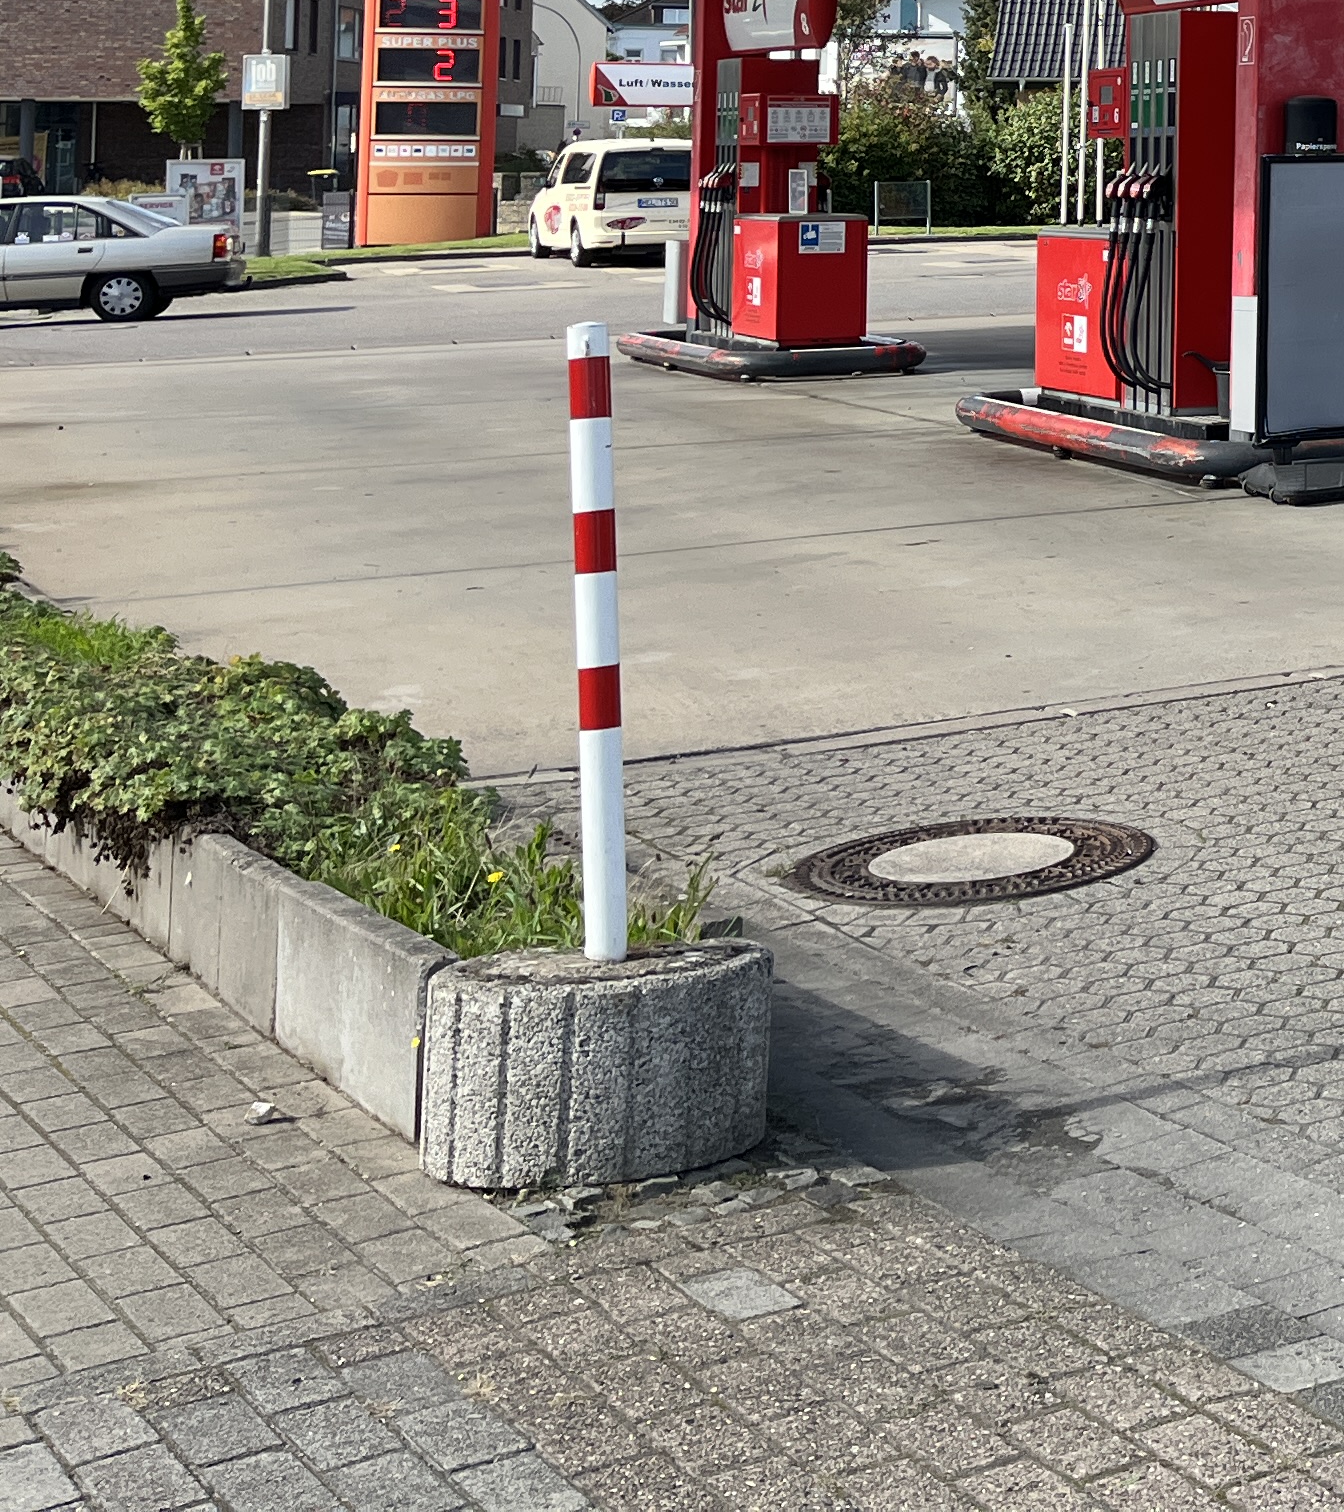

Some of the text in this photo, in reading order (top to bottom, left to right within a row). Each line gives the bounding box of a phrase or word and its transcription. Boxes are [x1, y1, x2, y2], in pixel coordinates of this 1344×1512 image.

[381, 36, 478, 48] SUPER PLUS
[618, 78, 644, 88] Luft
